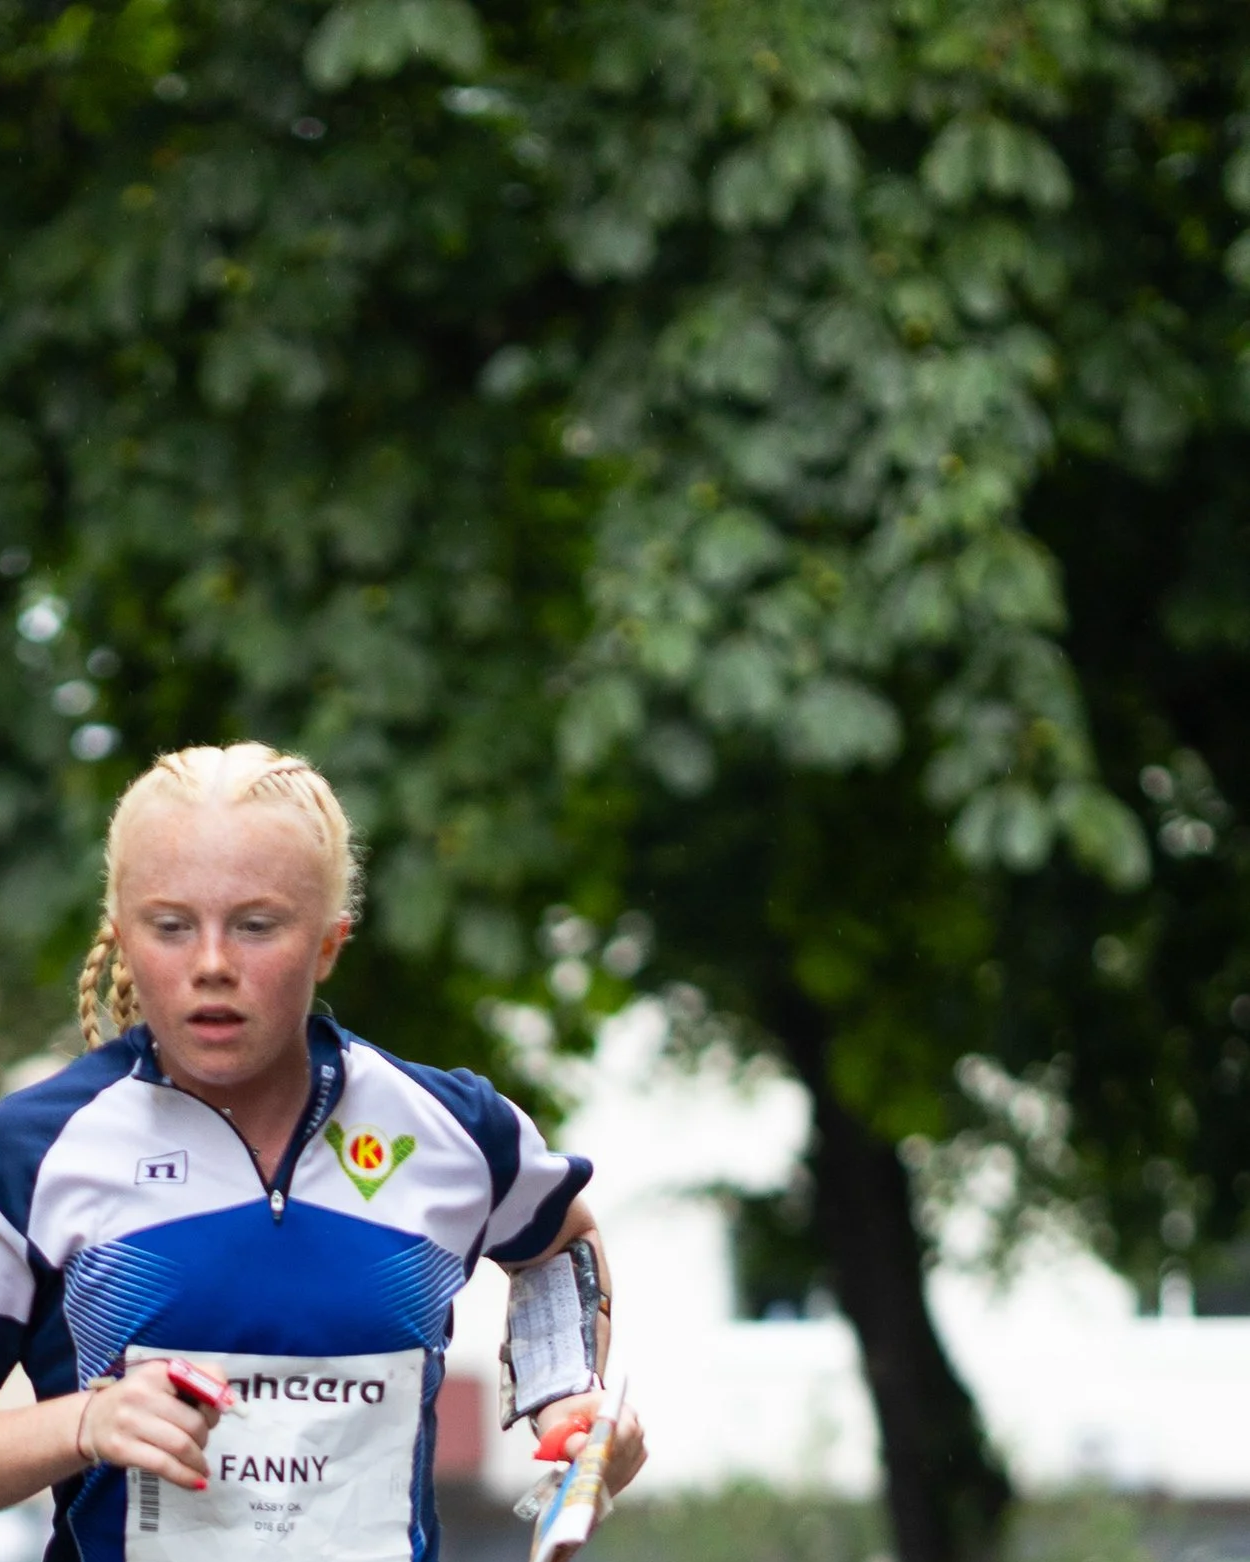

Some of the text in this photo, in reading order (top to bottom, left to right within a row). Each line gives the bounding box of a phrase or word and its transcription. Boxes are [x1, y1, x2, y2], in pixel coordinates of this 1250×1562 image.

[358, 1135, 381, 1168] K
[227, 1373, 385, 1404] gheera
[220, 1455, 329, 1483] FANNY
